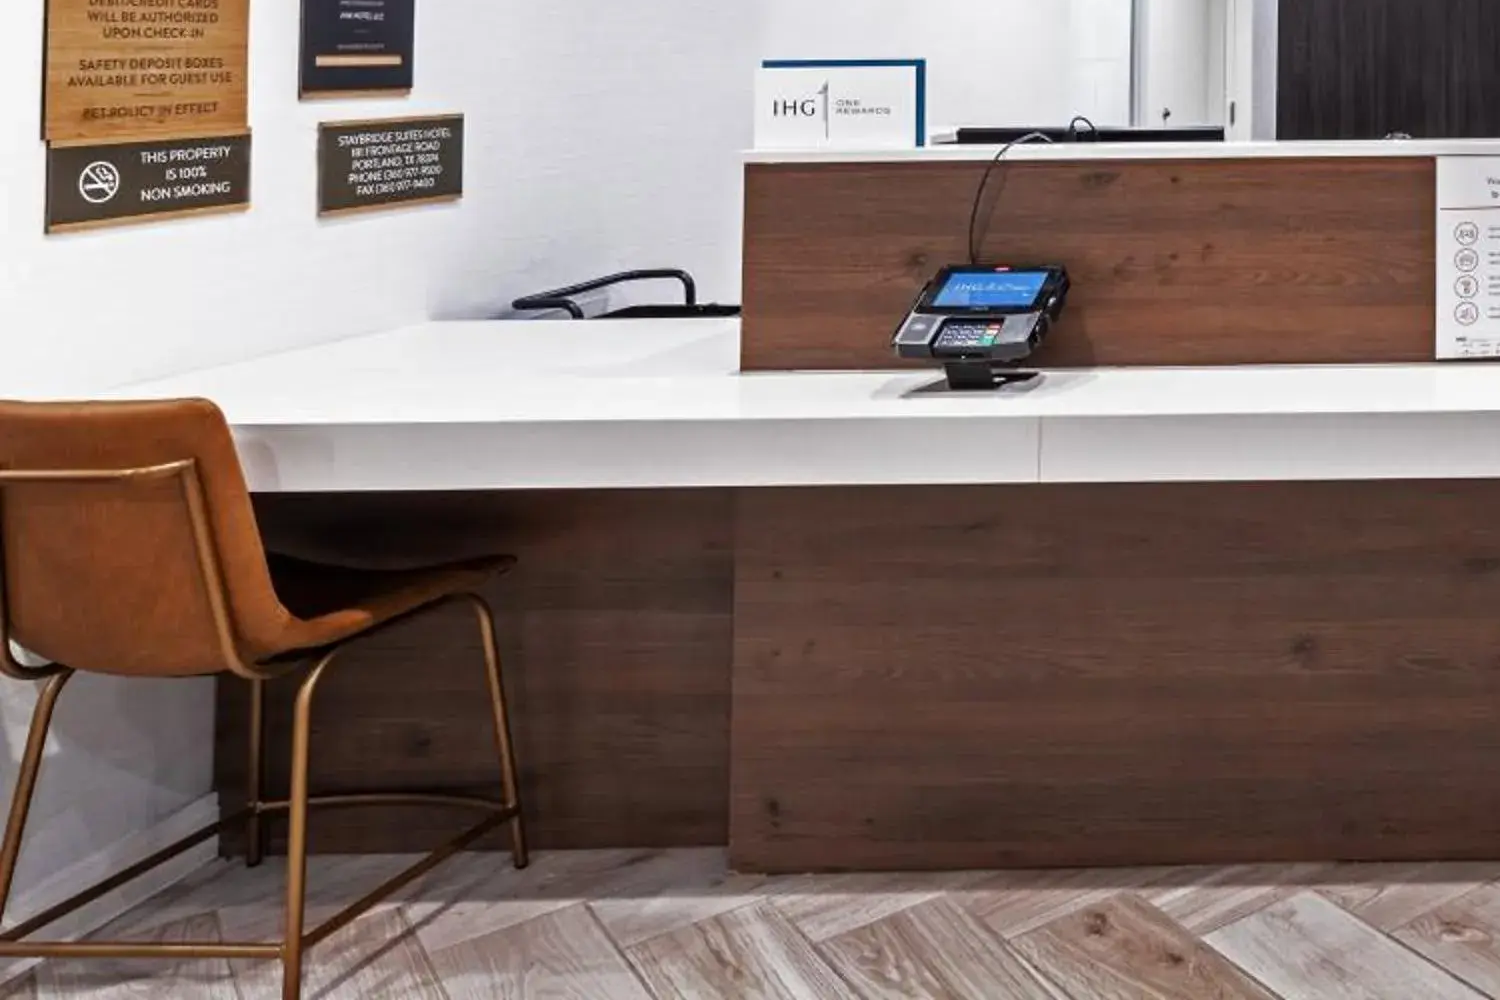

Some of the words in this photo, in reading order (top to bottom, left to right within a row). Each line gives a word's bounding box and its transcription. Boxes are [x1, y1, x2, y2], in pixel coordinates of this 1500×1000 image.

[87, 11, 117, 22] WILL
[121, 11, 138, 22] BE
[140, 11, 218, 23] AUTHORIZED
[102, 27, 142, 39] UPON
[79, 58, 125, 70] SAFETY
[129, 57, 183, 70] DEPOSIT
[186, 57, 224, 69] BOXES
[67, 74, 137, 87] AVAILABLE
[141, 73, 167, 85] FOR
[169, 72, 207, 85] GUEST
[210, 71, 232, 83] USE
[175, 101, 218, 115] EFFECT
[773, 99, 815, 117] IHG
[835, 99, 860, 107] ONE
[835, 107, 891, 115] REWARDS
[338, 132, 394, 147] STAYBRIDGE
[395, 129, 422, 142] SUITES
[415, 140, 440, 152] ROAD
[140, 151, 168, 165] THIS
[169, 145, 231, 161] PROPERTY
[165, 168, 177, 180] IS
[179, 165, 207, 179] 100%
[347, 169, 382, 185] PHONE
[140, 187, 171, 201] NON
[173, 181, 231, 199] SMOKING
[356, 183, 375, 195] FAX
